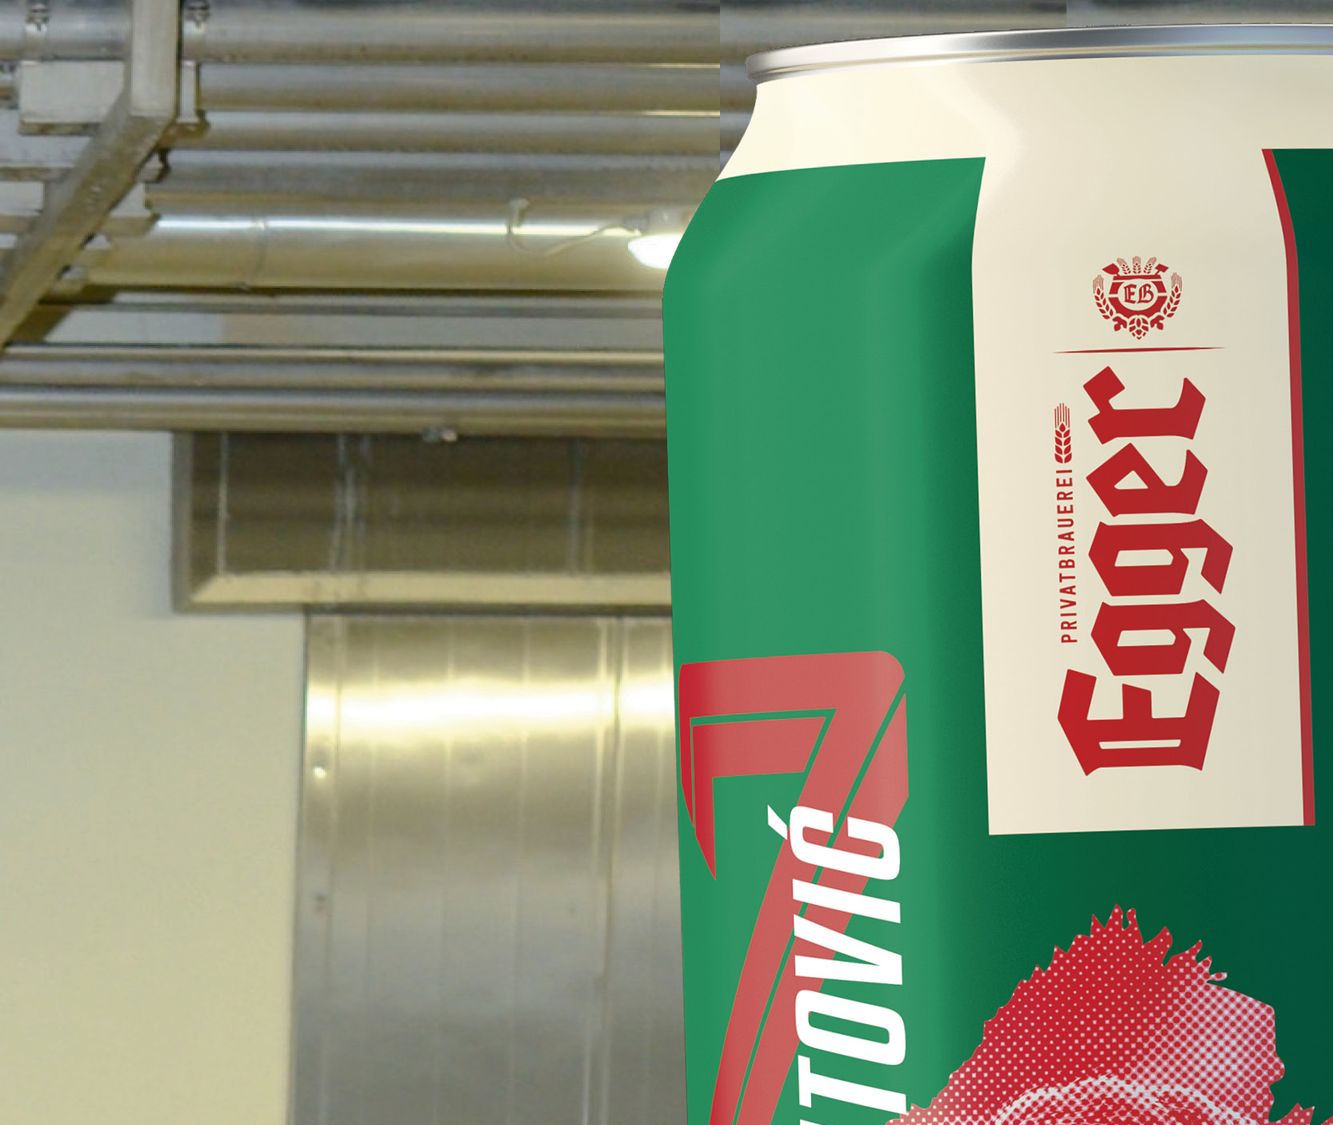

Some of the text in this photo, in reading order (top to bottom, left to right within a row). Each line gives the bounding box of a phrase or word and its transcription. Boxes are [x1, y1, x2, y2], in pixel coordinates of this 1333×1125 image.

[1123, 283, 1154, 304] EB
[1057, 366, 1236, 776] Egger
[1059, 468, 1078, 645] PRIVATBRAUEREI
